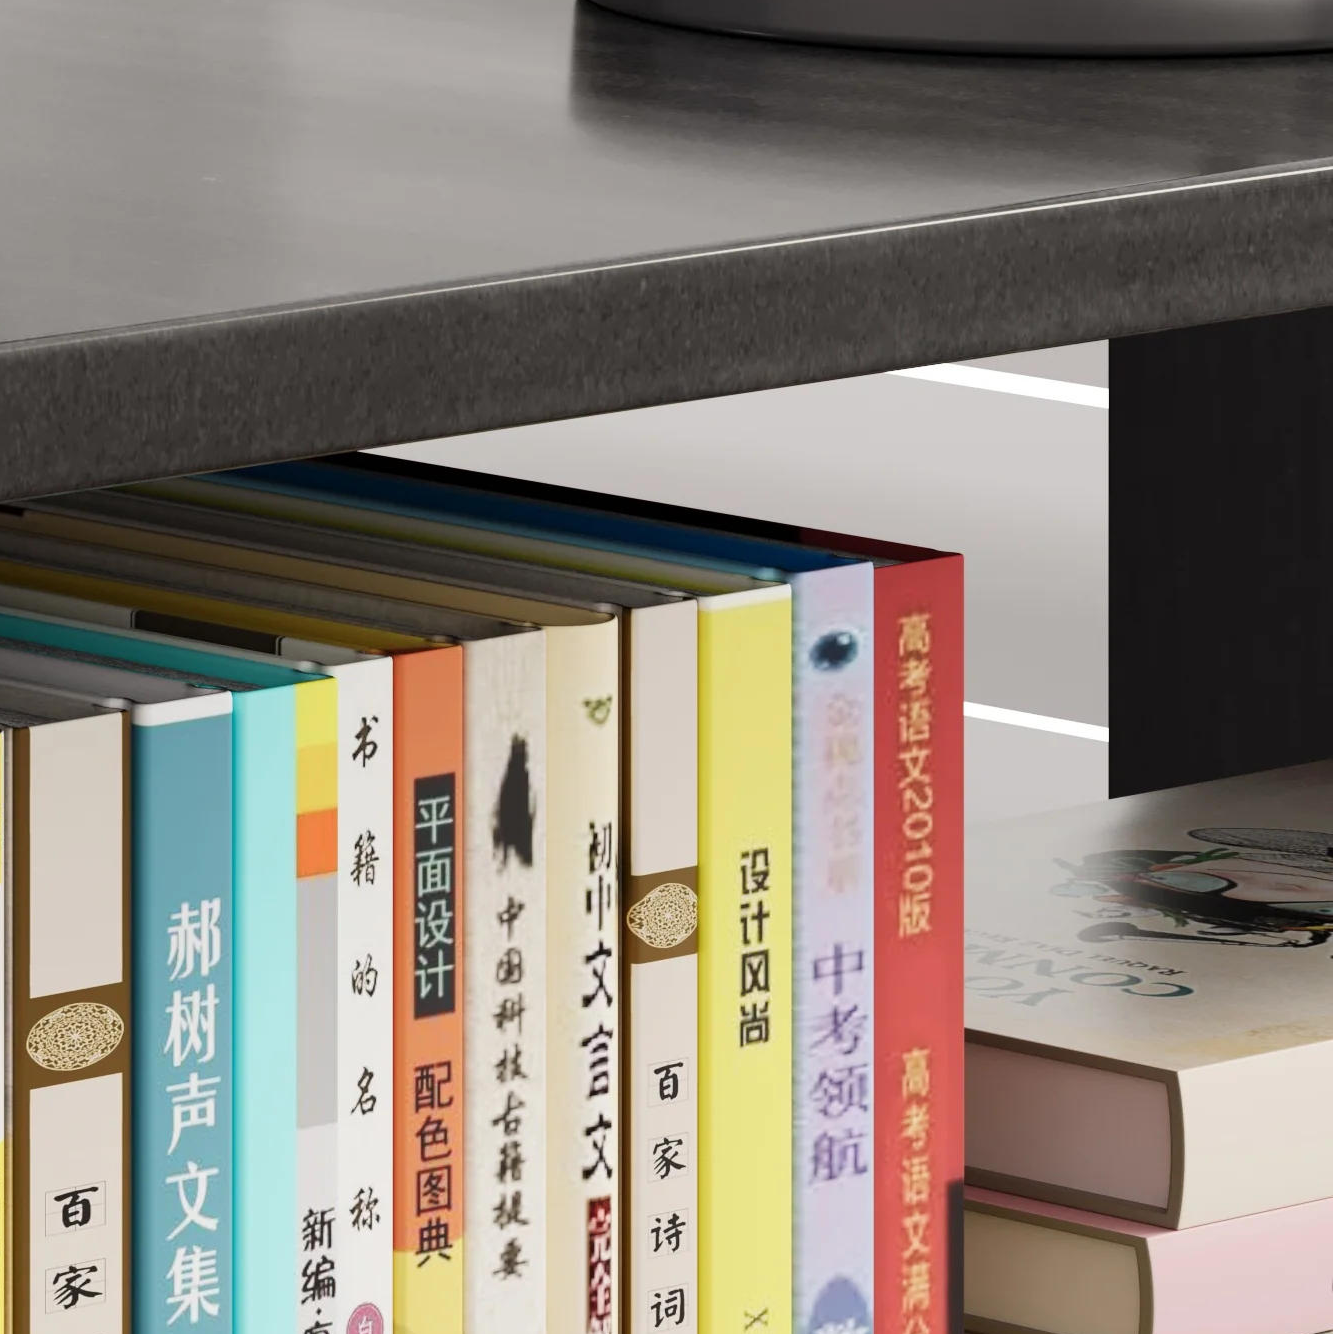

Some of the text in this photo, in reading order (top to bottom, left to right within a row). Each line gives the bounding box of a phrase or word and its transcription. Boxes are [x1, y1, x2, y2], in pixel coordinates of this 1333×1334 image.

[350, 715, 381, 1232] 书籍的名称
[414, 794, 454, 999] 平面设计
[740, 847, 770, 1048] 设计风尚
[164, 897, 221, 1326] 郝树声文集
[414, 1060, 454, 1267] 配色图典
[808, 942, 869, 1183] 中考领航
[649, 1062, 687, 1328] 百家诗词
